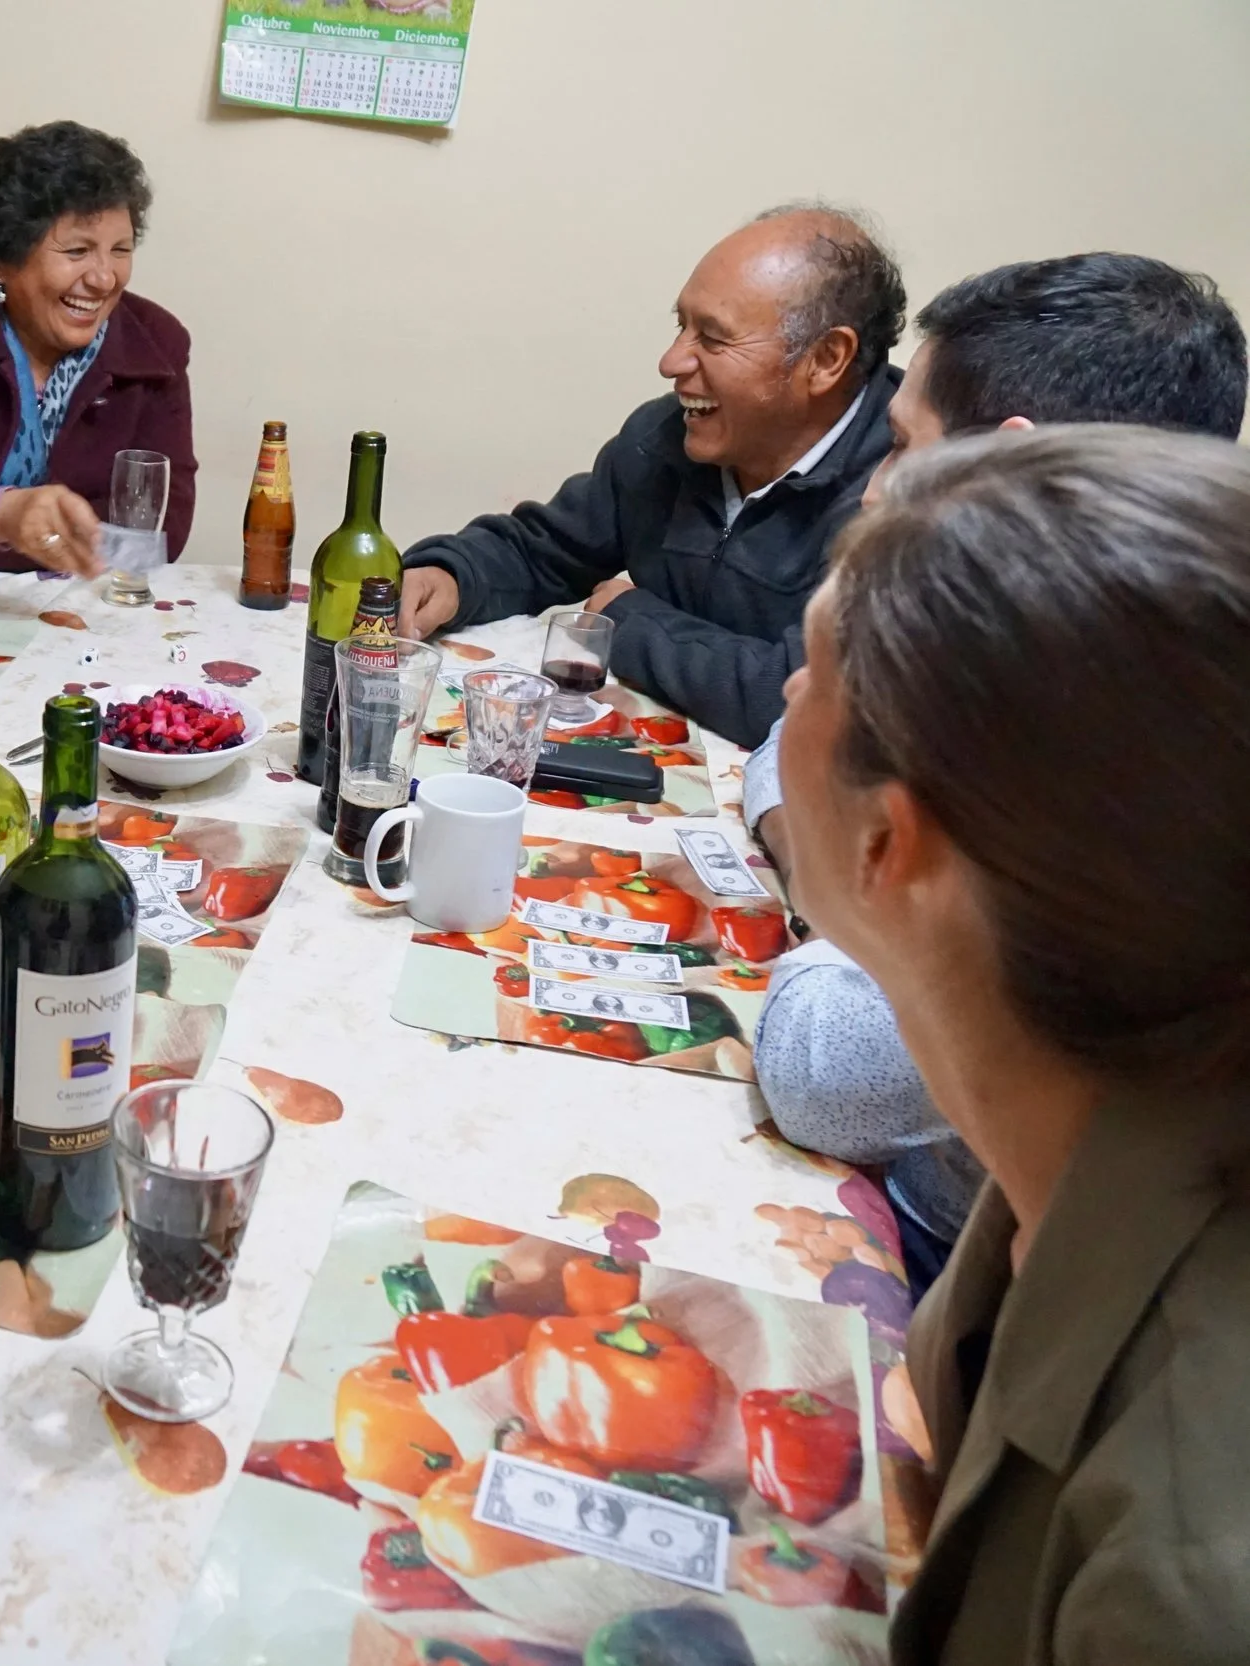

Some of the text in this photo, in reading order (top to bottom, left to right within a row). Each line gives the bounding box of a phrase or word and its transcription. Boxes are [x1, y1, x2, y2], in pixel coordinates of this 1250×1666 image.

[241, 14, 291, 31] Octubre
[313, 22, 380, 39] Noviembre
[395, 30, 460, 47] Diciembre
[349, 650, 395, 667] CUSQUEÑA
[49, 1135, 76, 1146] SAN
